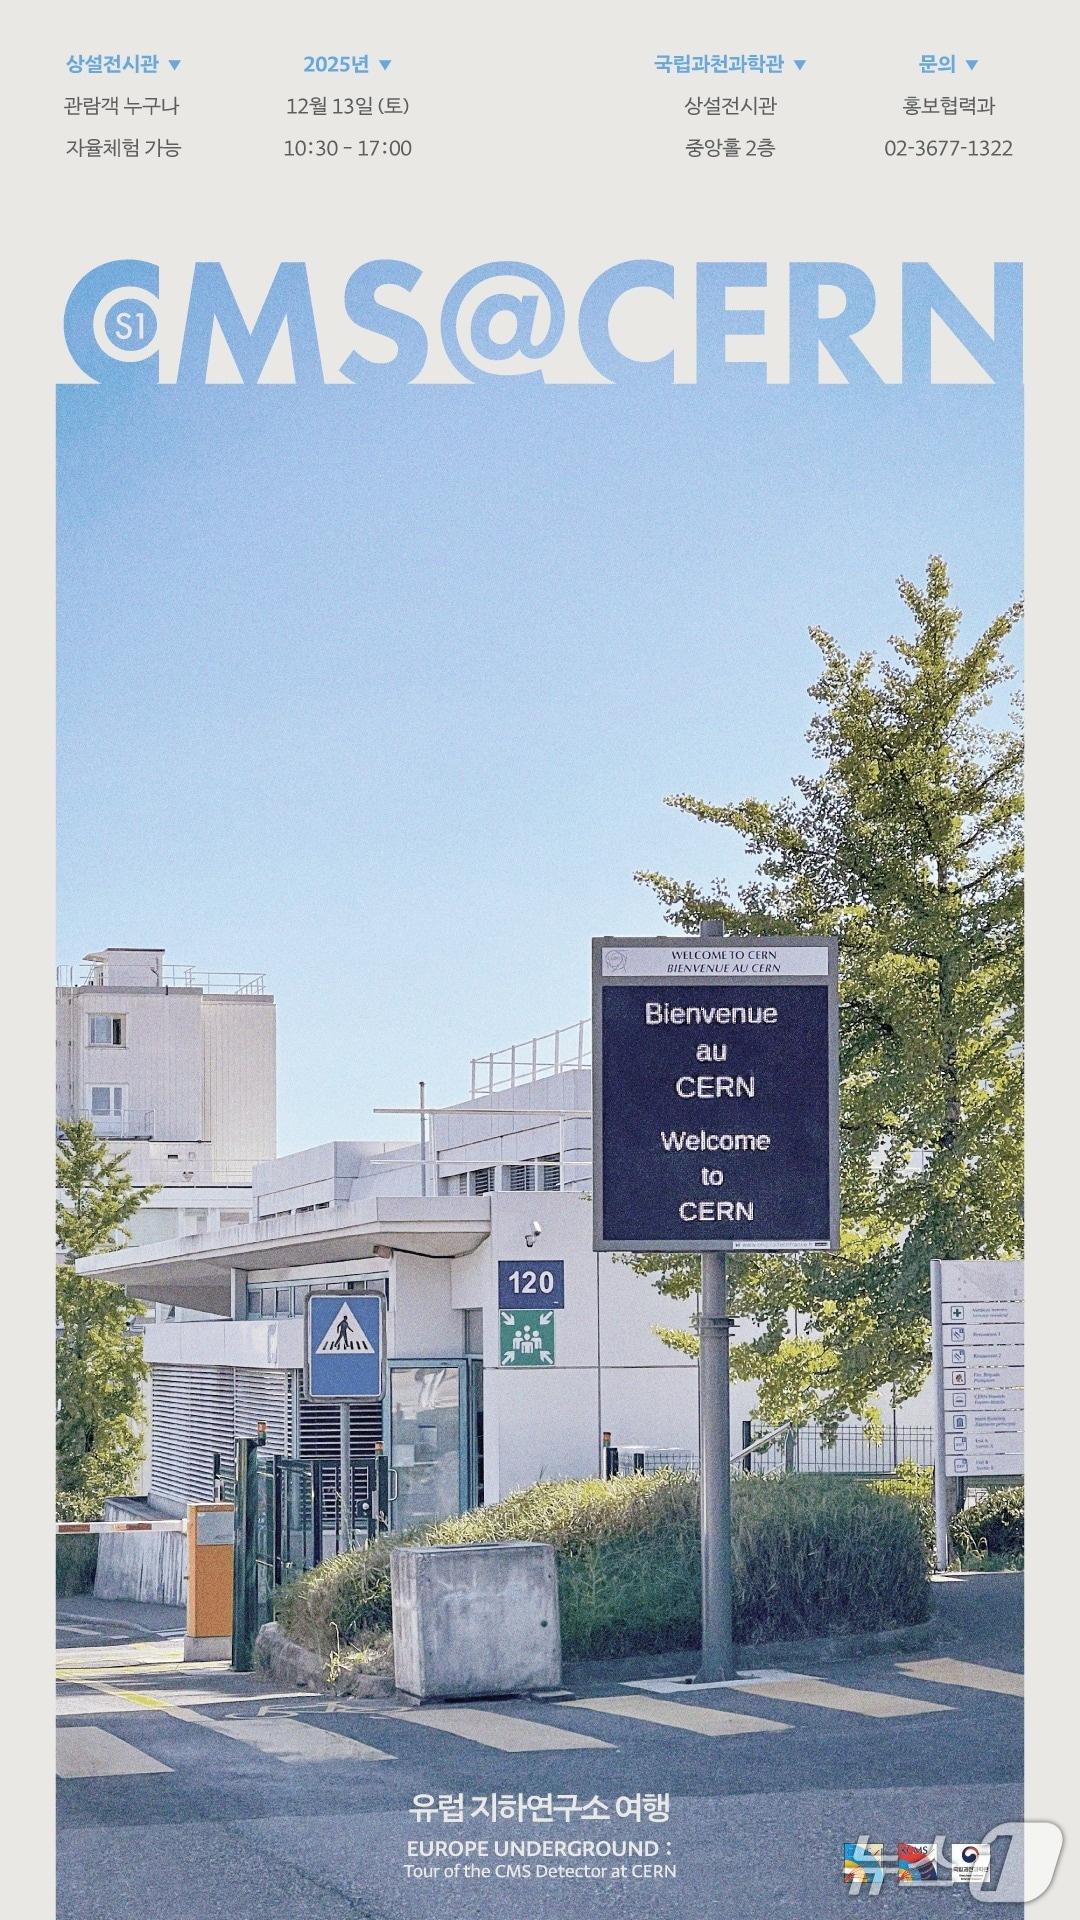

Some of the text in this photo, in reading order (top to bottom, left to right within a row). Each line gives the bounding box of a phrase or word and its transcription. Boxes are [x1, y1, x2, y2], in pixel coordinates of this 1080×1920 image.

[66, 54, 159, 74] 상설전시관
[303, 54, 369, 74] 2025년
[654, 54, 785, 74] 국립과천과학관
[918, 54, 956, 74] 문의
[63, 96, 180, 116] 관람객 누구나
[286, 96, 410, 116] 12월 13일 (토)
[684, 96, 778, 116] 상설전시관
[903, 96, 996, 116] 홍보협력과
[66, 138, 182, 158] 자율체험 가능
[283, 139, 339, 157] 10:30
[357, 139, 413, 157] 17:00
[684, 138, 776, 158] 중앙홀 2층
[884, 139, 1014, 157] 02-3677-1322
[63, 258, 1023, 385] CMS@CERN
[115, 312, 144, 340] S1
[671, 950, 777, 960] WELCOME TO CERN
[667, 963, 781, 973] BIENVENUE AU CERN
[645, 1002, 778, 1025] Bienvenue
[696, 1043, 727, 1062] au
[675, 1076, 755, 1099] CERN
[661, 1129, 771, 1152] Welcome
[701, 1167, 724, 1186] to
[678, 1201, 755, 1222] CERN
[508, 1270, 555, 1294] 120
[408, 1792, 670, 1823] 유럽 지하연구소 여행
[407, 1840, 489, 1857] EUROPE
[494, 1840, 659, 1857] UNDERGROUND
[404, 1863, 677, 1879] Tour of the CMS Detector at CERN
